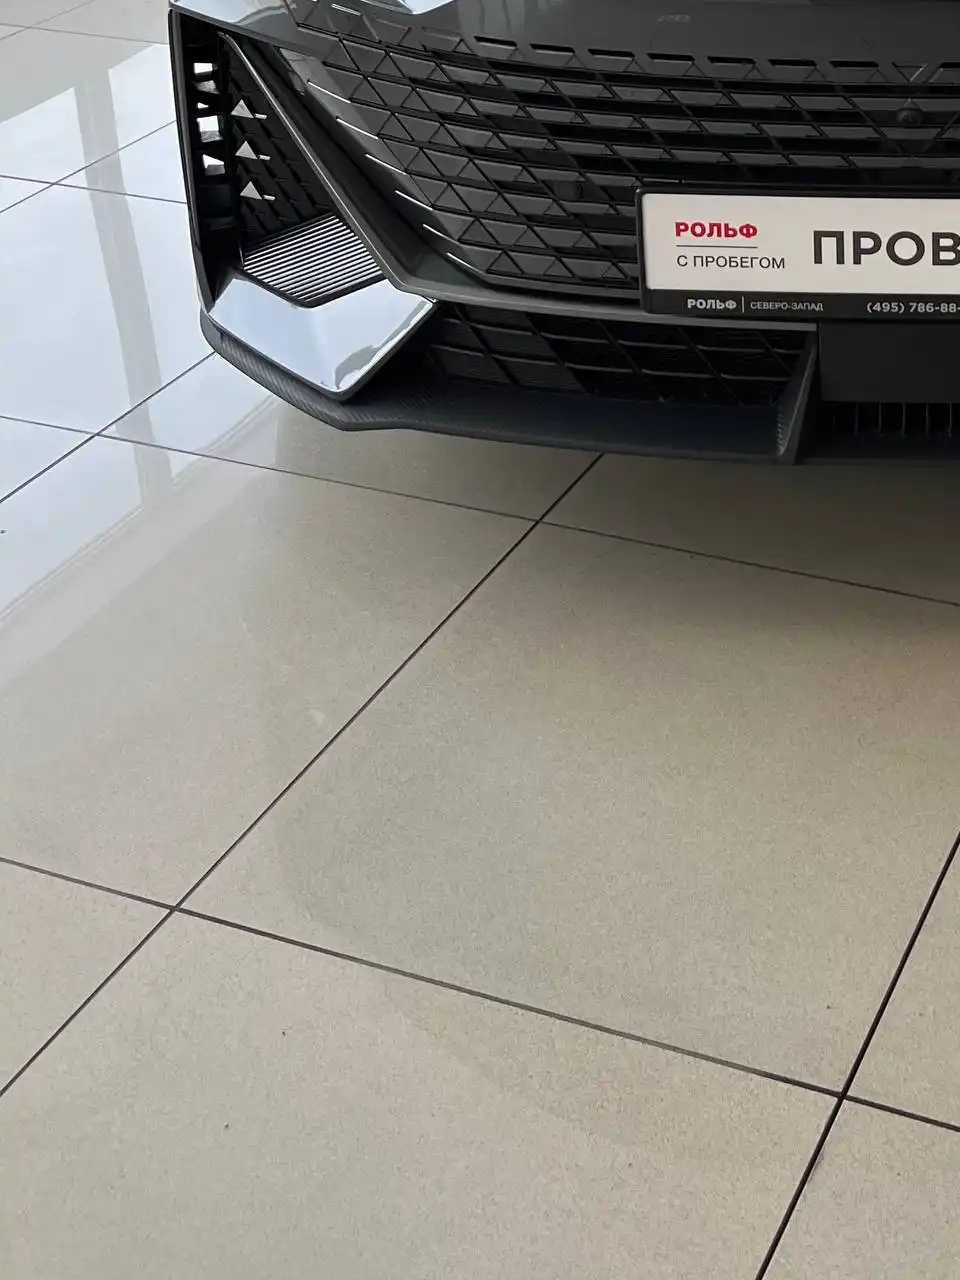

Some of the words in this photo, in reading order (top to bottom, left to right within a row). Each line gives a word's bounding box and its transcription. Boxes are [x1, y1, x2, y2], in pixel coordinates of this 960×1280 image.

[675, 221, 758, 239] РОЛЬФ
[676, 255, 688, 267] С
[693, 256, 786, 269] ПРОБЕГОМ
[687, 298, 737, 310] РОЛЬФ
[750, 300, 824, 312] СЕВЕРО-ЗАПАД
[866, 302, 905, 314] (495)
